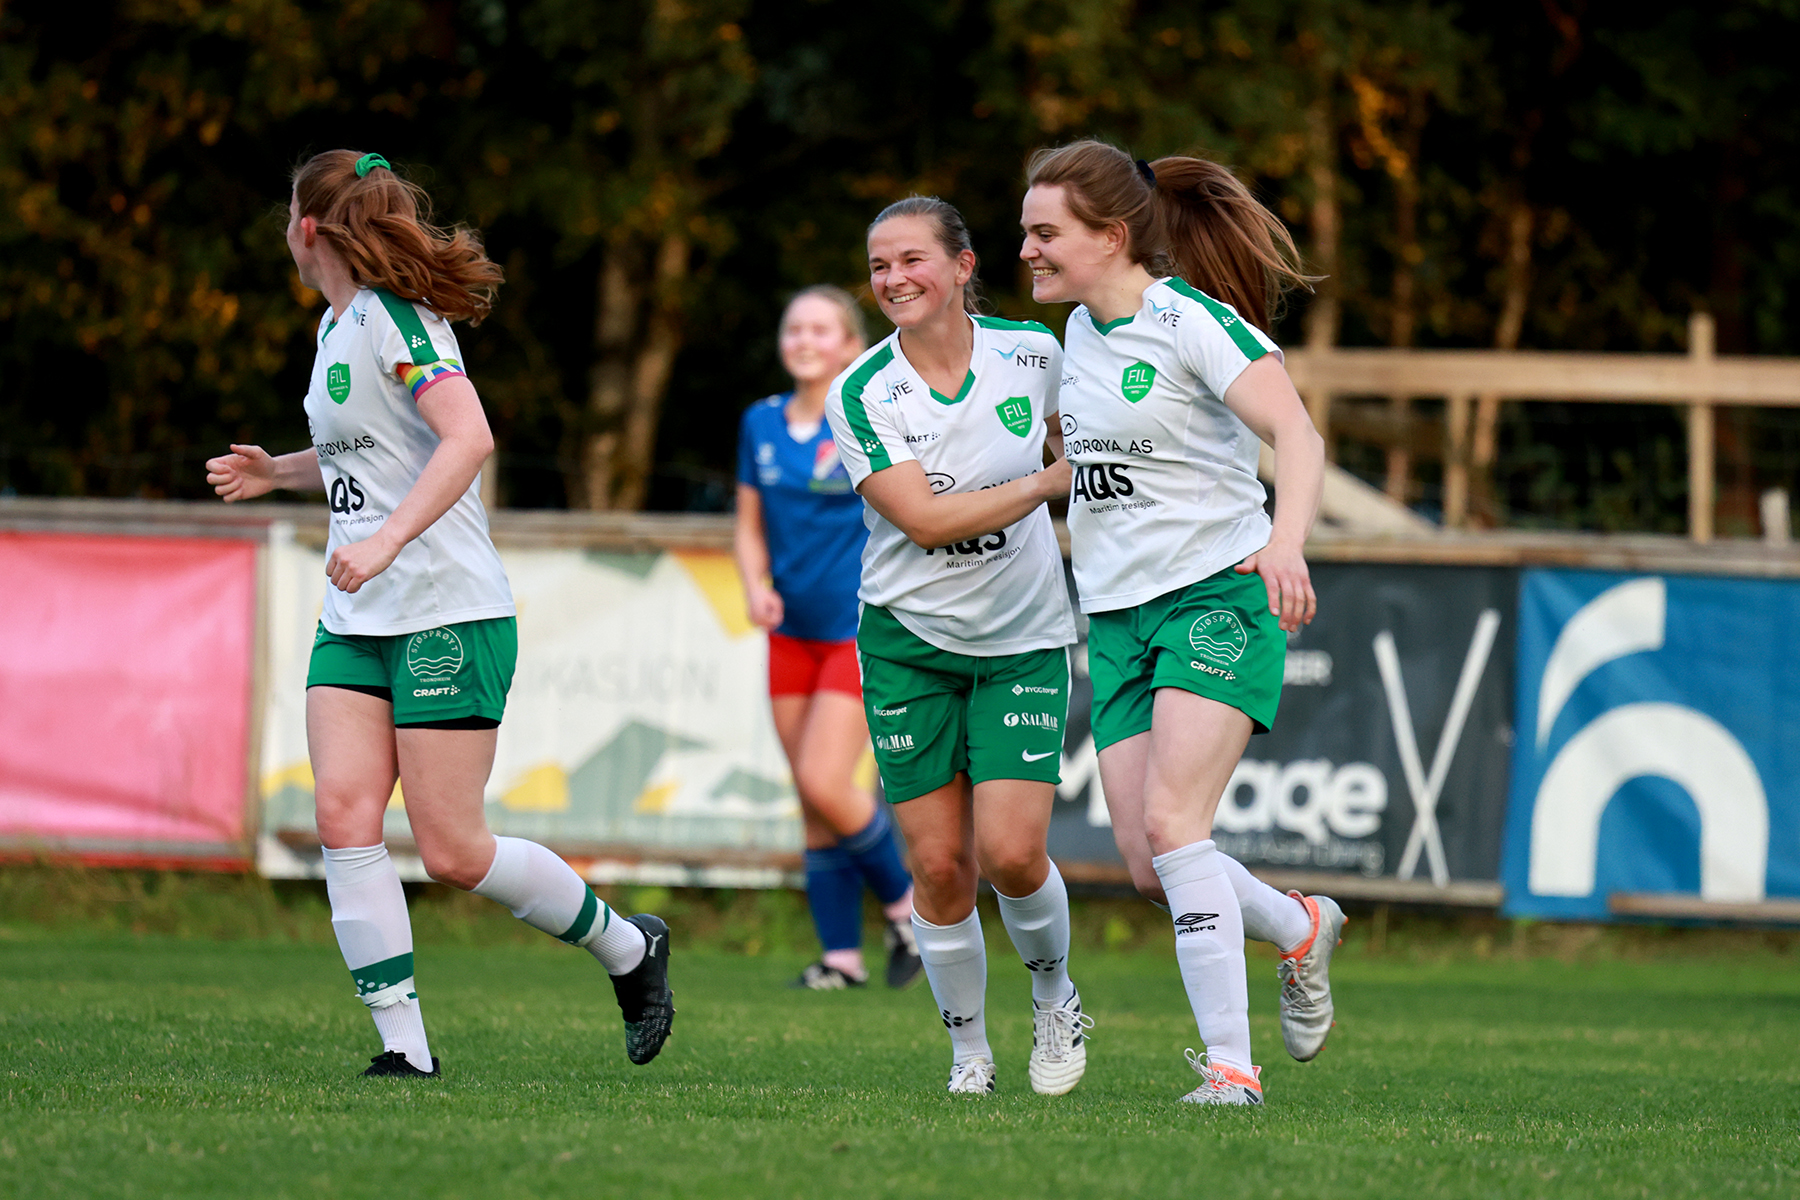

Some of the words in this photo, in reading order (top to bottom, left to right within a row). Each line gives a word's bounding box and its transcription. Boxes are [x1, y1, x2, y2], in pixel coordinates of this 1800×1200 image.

[1158, 312, 1181, 327] NTE
[1016, 354, 1049, 369] NTE
[330, 369, 347, 385] FIL
[1127, 369, 1149, 383] FIL
[1003, 402, 1028, 421] FIL
[354, 435, 375, 452] AS
[903, 433, 930, 443] RAFT
[1129, 438, 1153, 454] AS
[1073, 463, 1135, 504] AQS
[330, 475, 365, 515] QS
[1089, 503, 1120, 515] Maritim
[1121, 500, 1156, 512] presisjon
[926, 529, 1007, 556] QS
[946, 559, 984, 569] Maritim
[411, 630, 459, 654] SJØSPRØYT
[1190, 660, 1227, 677] CRAFT
[413, 687, 450, 697] CRAFT
